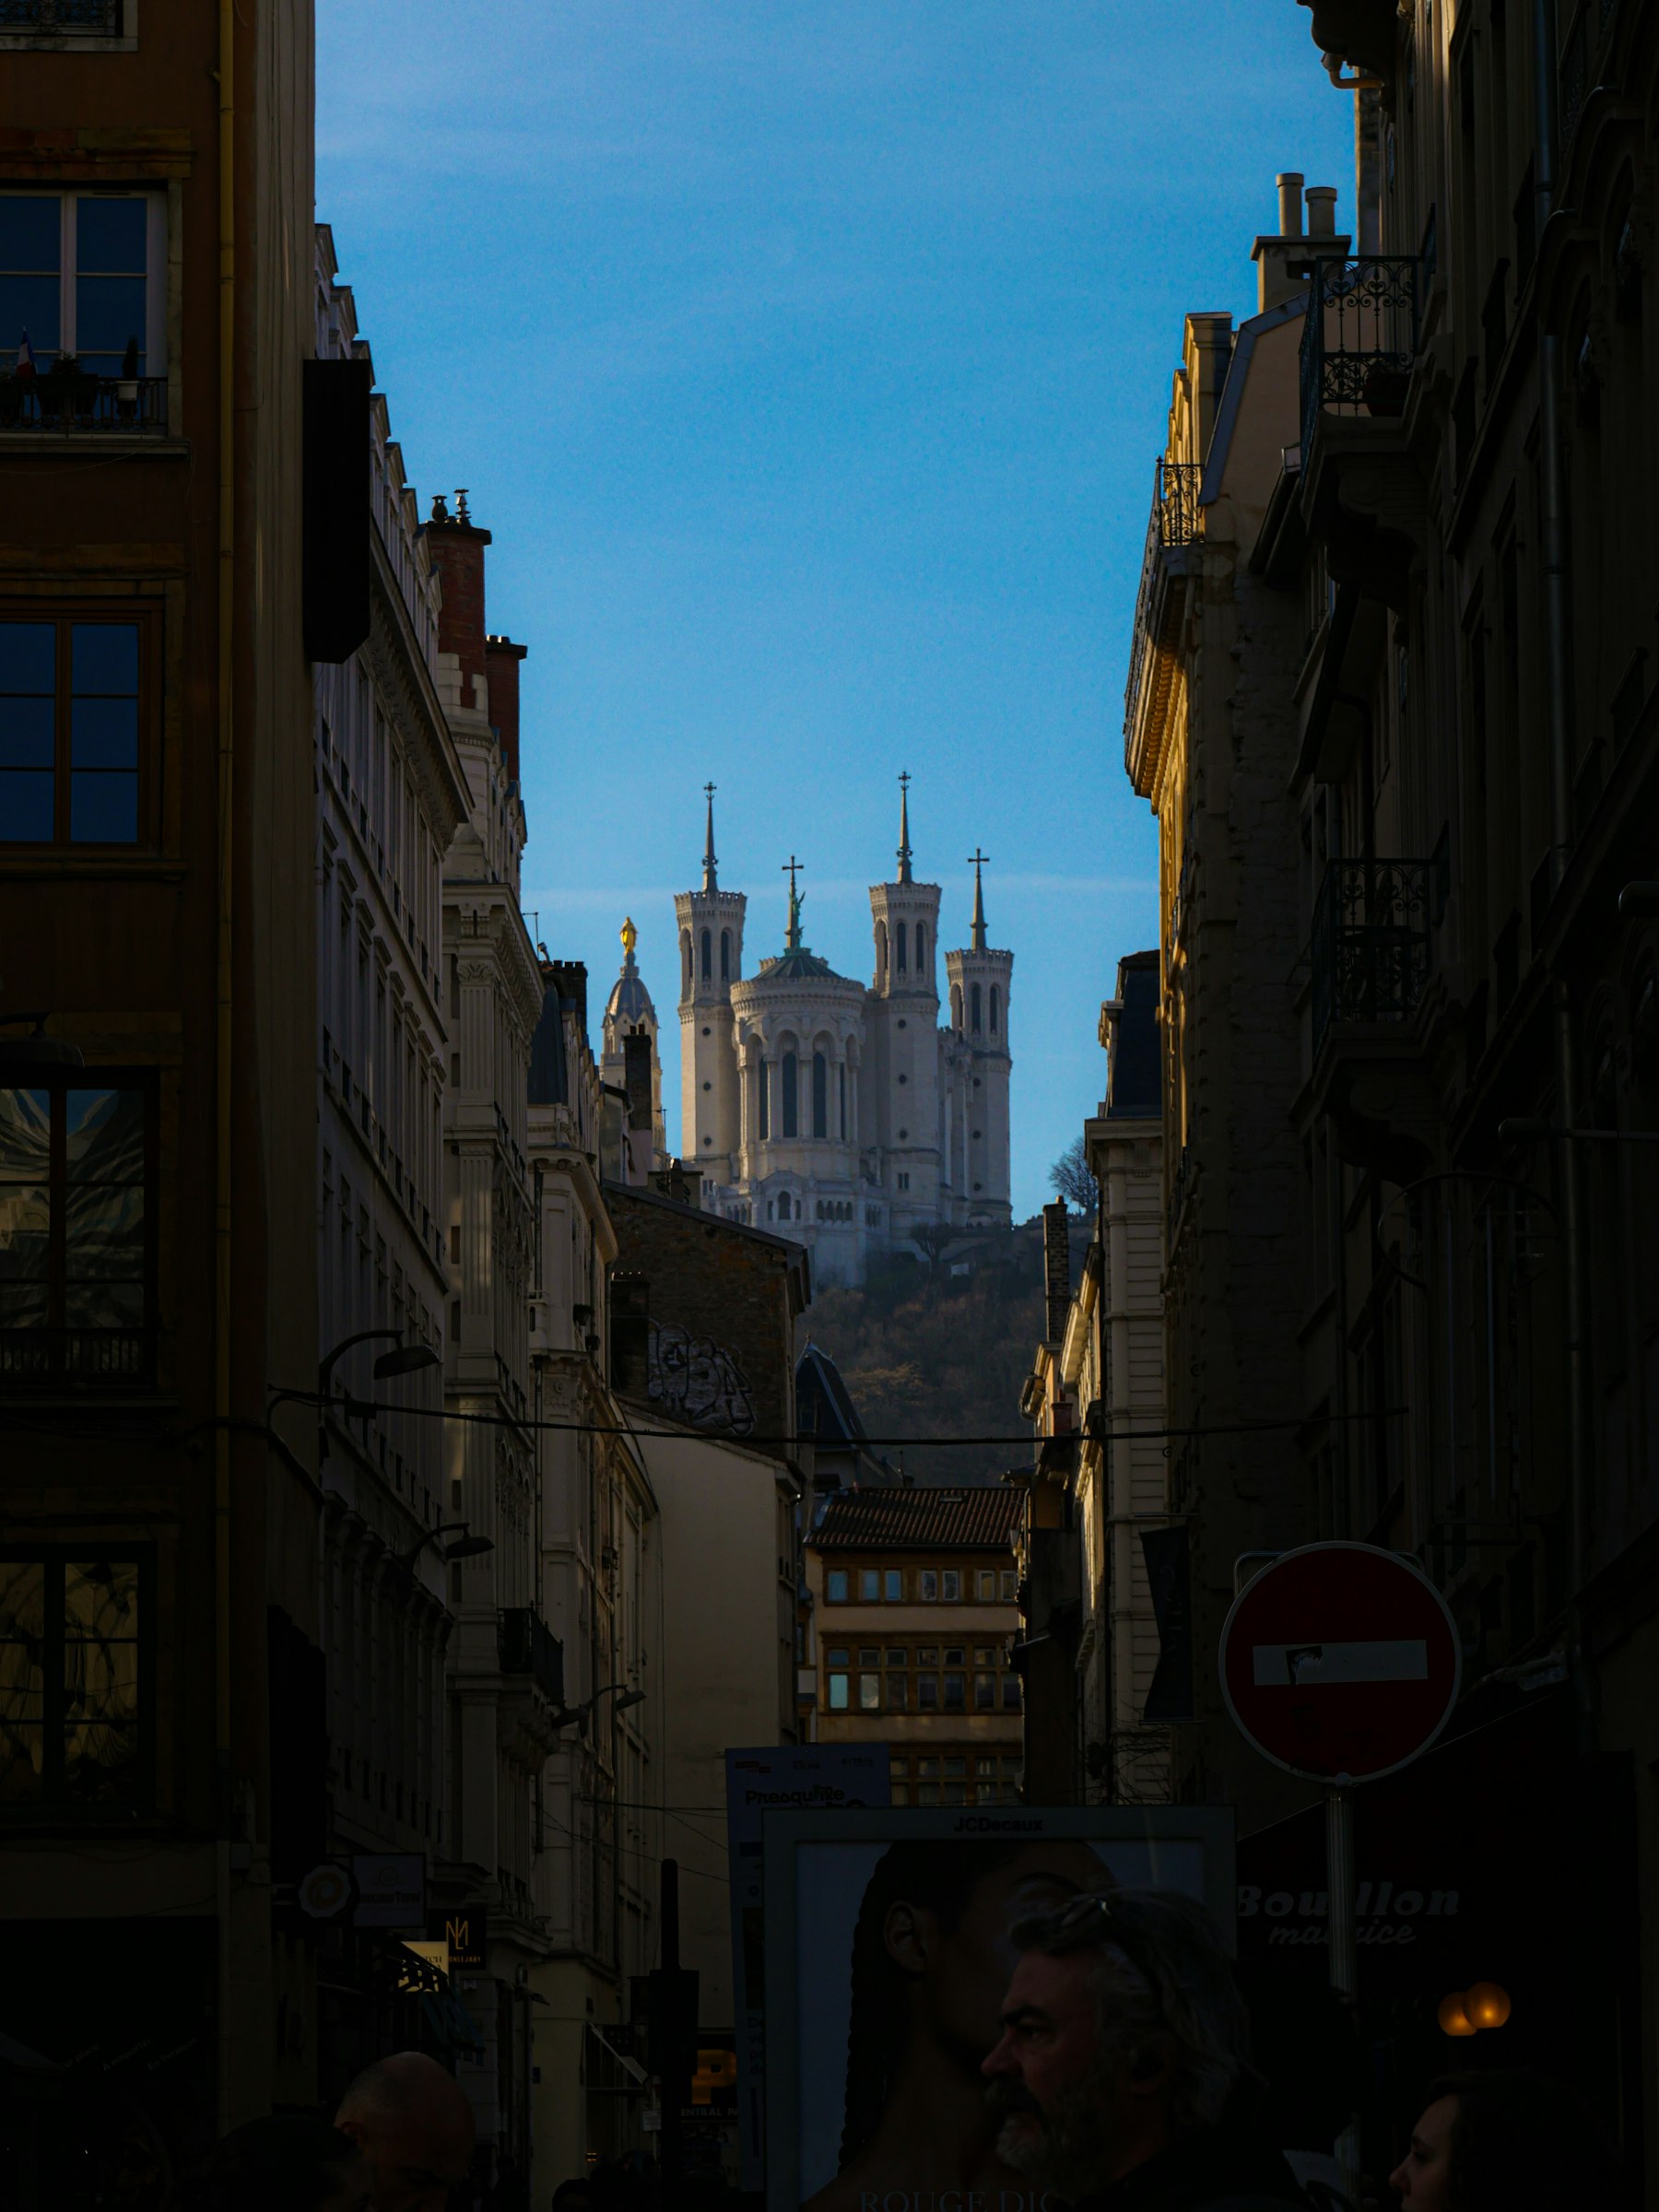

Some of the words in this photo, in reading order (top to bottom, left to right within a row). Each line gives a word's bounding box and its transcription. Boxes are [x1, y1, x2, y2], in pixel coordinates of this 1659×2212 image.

[954, 1817, 1043, 1832] JCDecaux
[1237, 1880, 1461, 1917] Boullon
[1267, 1917, 1417, 1946] maice
[680, 2107, 723, 2117] ENTRAL
[859, 2190, 988, 2212] ROUGE
